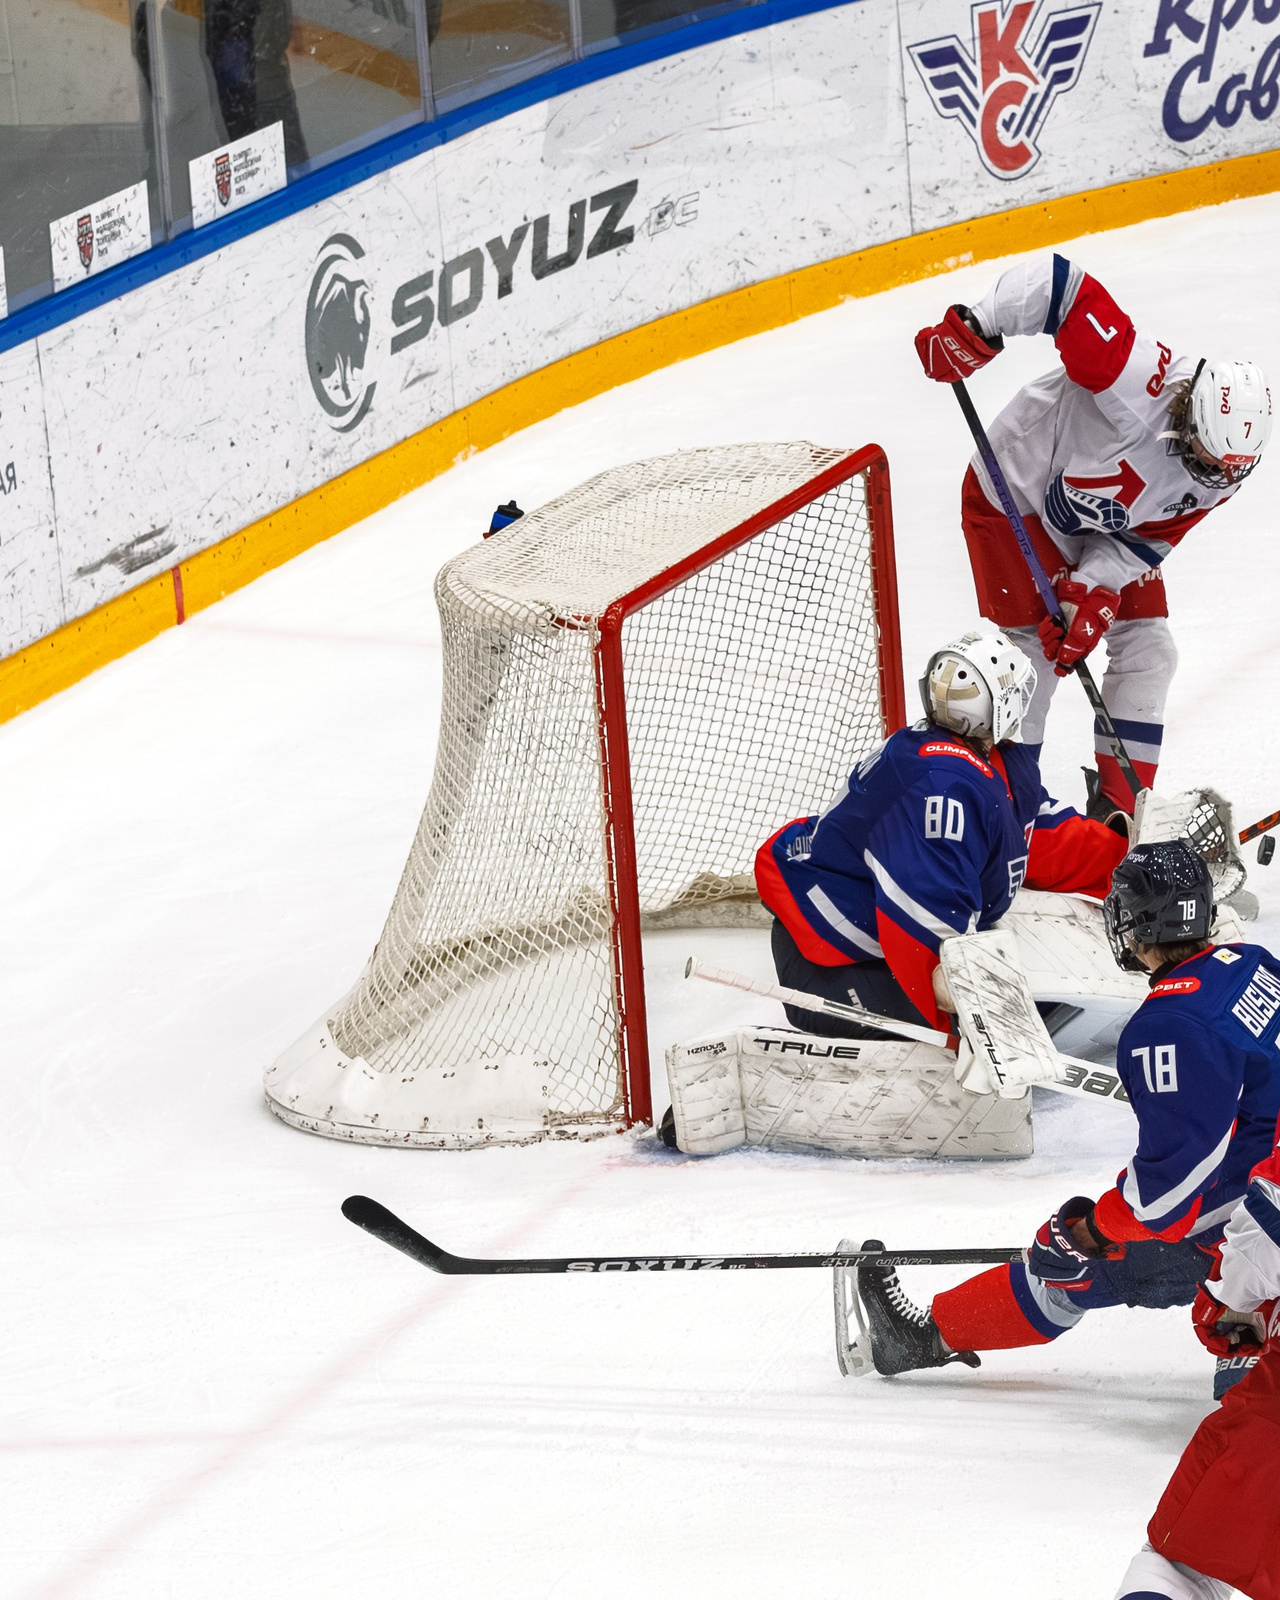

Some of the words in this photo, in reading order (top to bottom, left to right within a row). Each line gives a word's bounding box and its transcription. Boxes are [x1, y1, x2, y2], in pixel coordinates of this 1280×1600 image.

[390, 179, 639, 357] SOYUZ
[1085, 312, 1118, 343] 7
[1244, 422, 1252, 439] 7
[925, 745, 989, 772] OLIMPBET
[924, 796, 965, 842] 80
[1178, 899, 1196, 920] 78
[753, 1038, 861, 1059] TRUE
[971, 1013, 1007, 1085] TRUE
[1131, 1044, 1179, 1093] 78
[565, 1258, 726, 1274] SOYUZ
